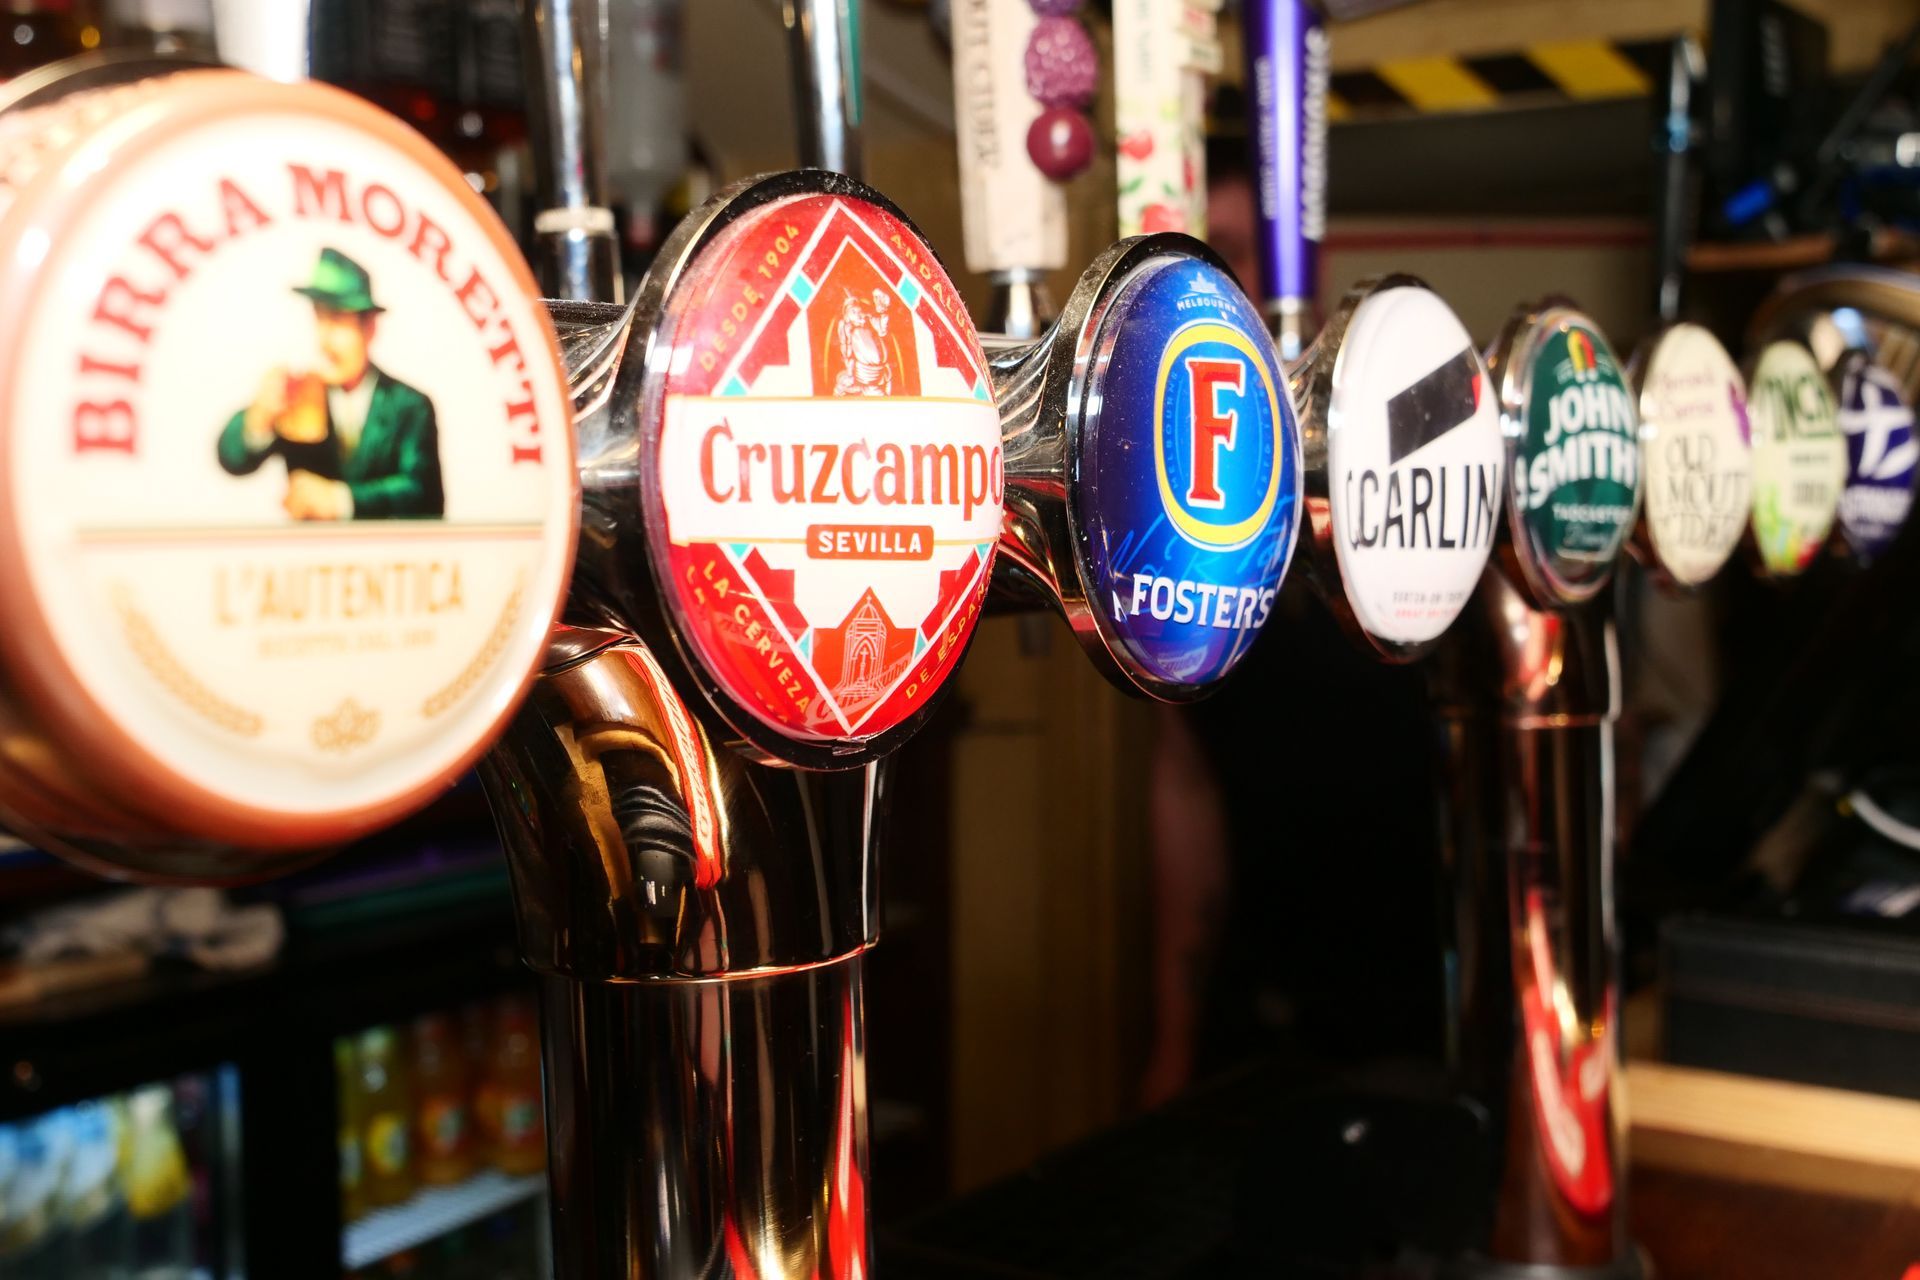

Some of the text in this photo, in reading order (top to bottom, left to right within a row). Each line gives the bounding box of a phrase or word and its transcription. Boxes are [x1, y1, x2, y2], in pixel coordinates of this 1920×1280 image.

[71, 163, 544, 466] BIRRA MORETTI
[700, 224, 800, 371] DESDE 1904
[1185, 357, 1245, 509] F
[1544, 382, 1636, 446] JOHN
[700, 417, 1002, 521] Cruzcampo
[817, 531, 922, 555] SEVILLA
[211, 560, 463, 628] L'AUTENTICA
[702, 560, 811, 714] LA CERVEZA
[1130, 574, 1278, 629] FOSTER'S
[905, 671, 930, 700] DE
